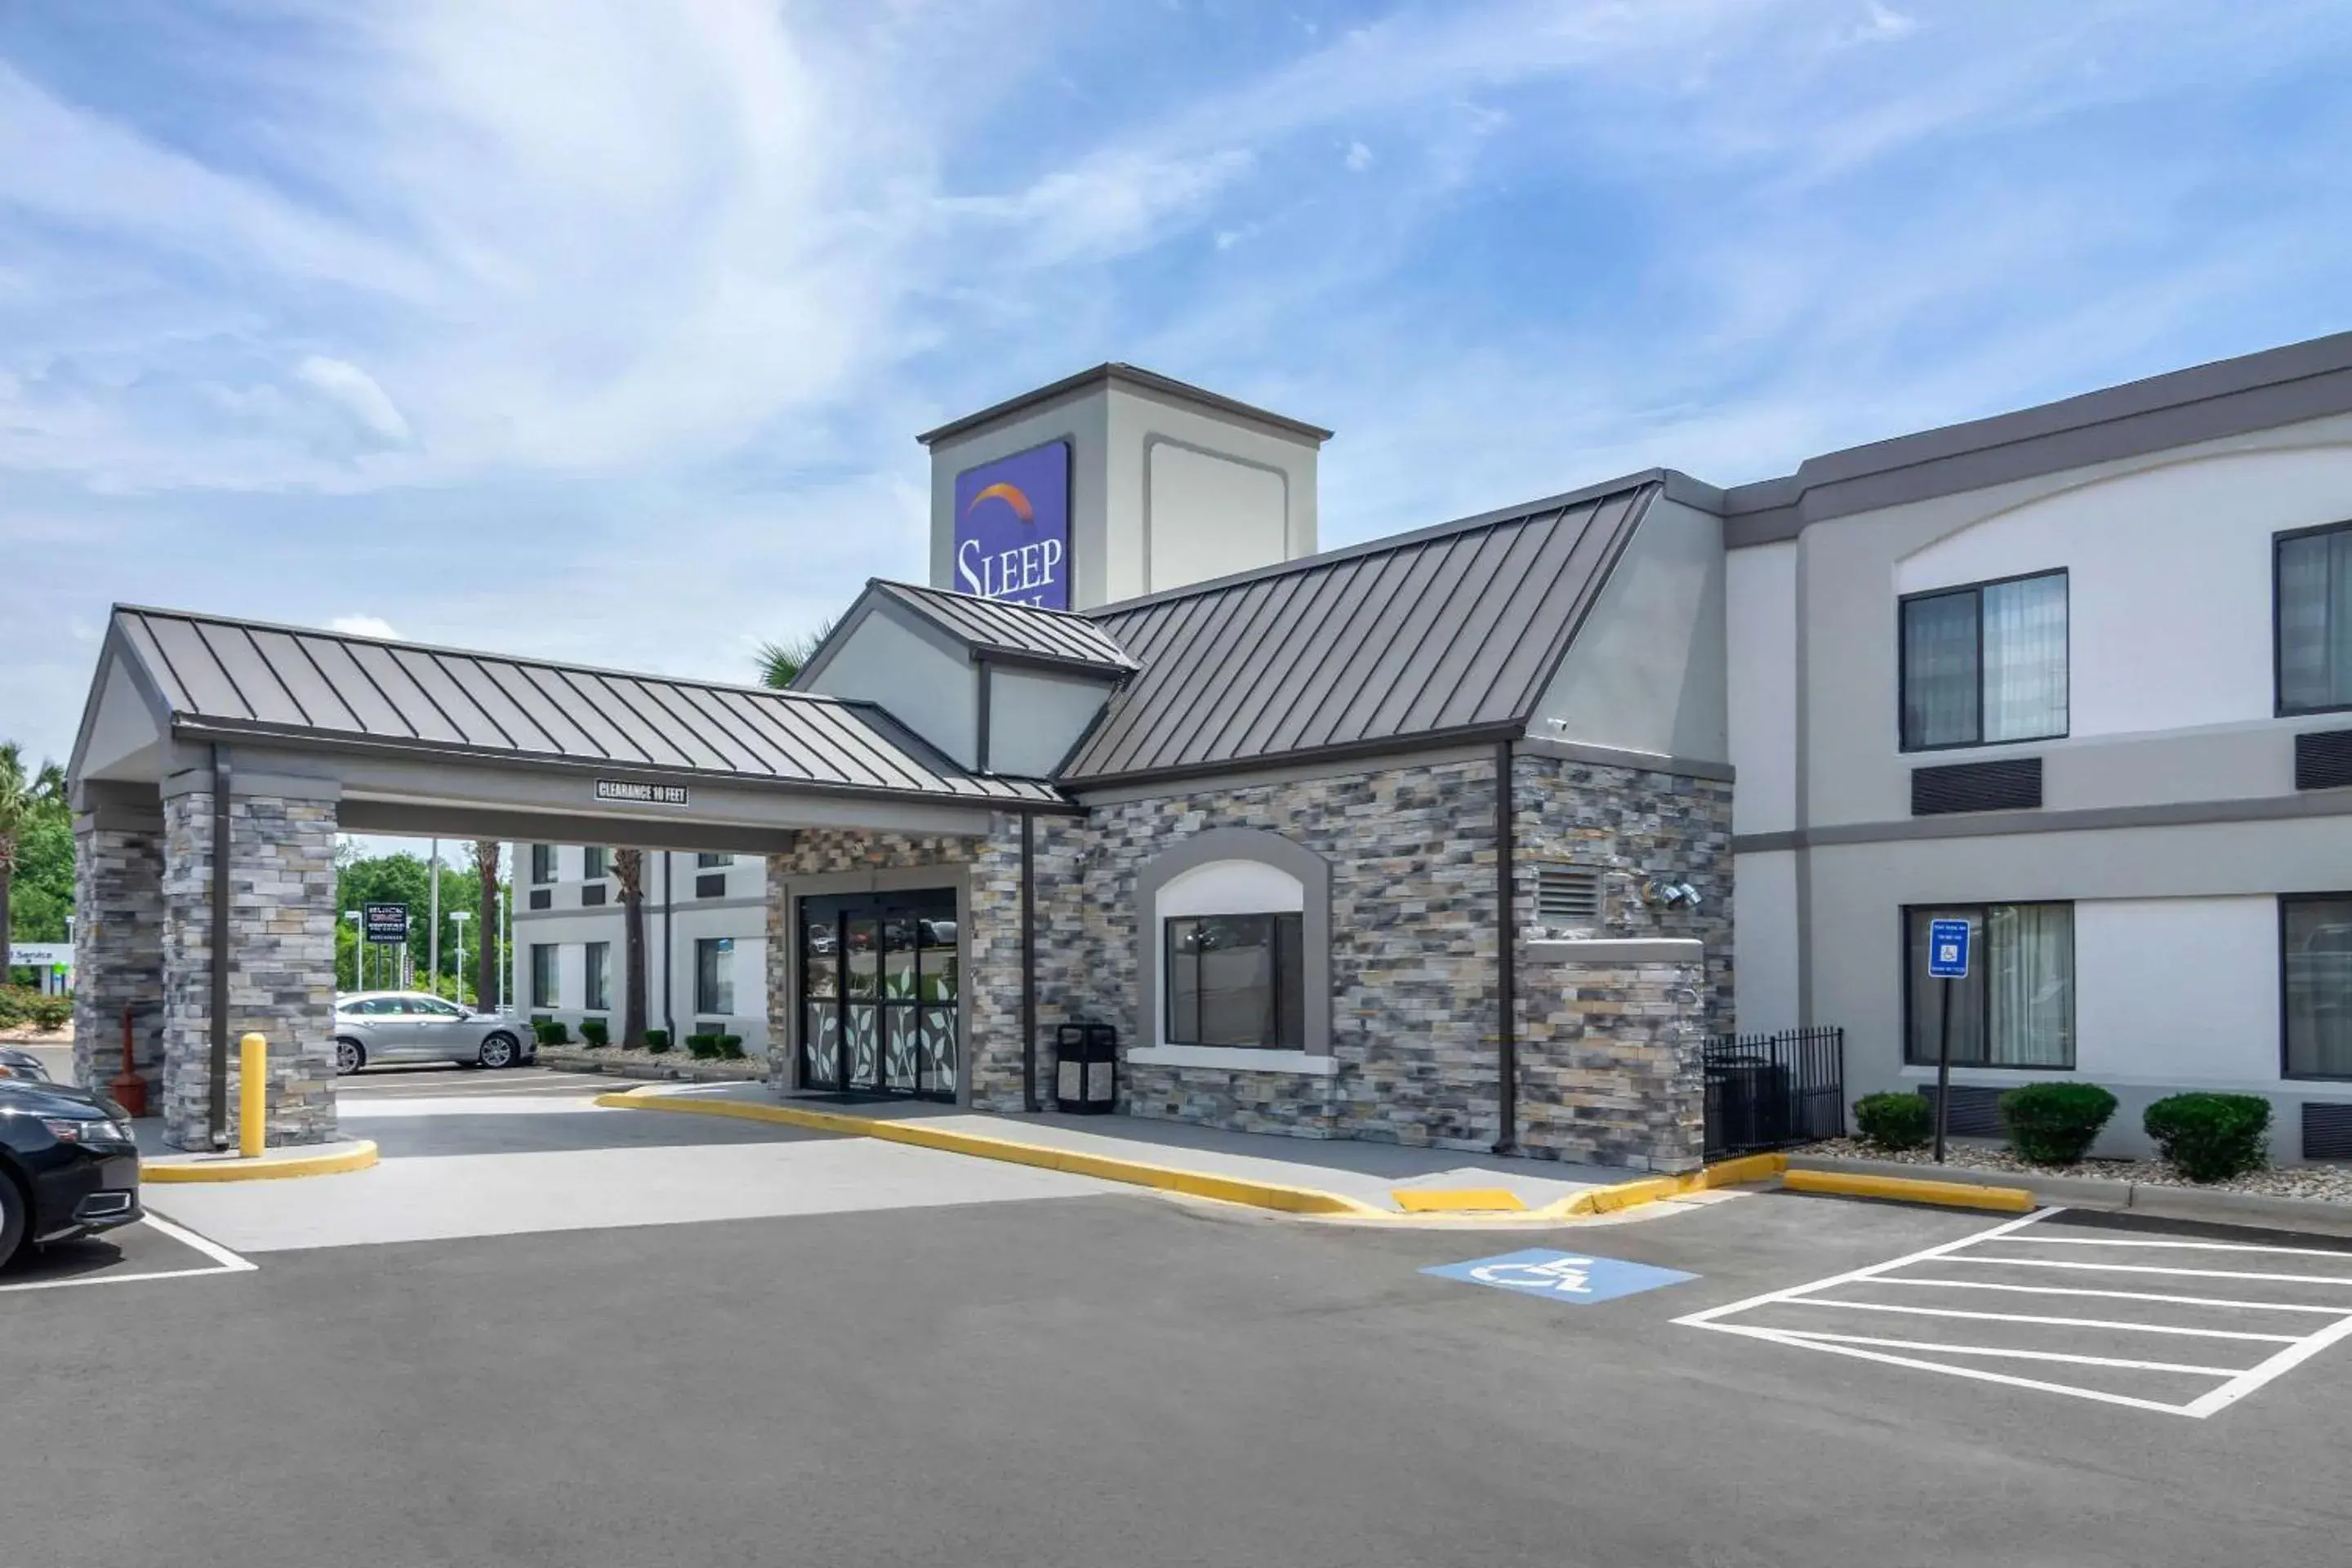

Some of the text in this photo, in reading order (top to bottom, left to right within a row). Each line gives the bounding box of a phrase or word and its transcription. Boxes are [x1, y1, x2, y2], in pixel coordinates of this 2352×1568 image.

[959, 538, 1062, 599] SLEEP
[598, 782, 686, 803] CLEARANCE 10 FEET
